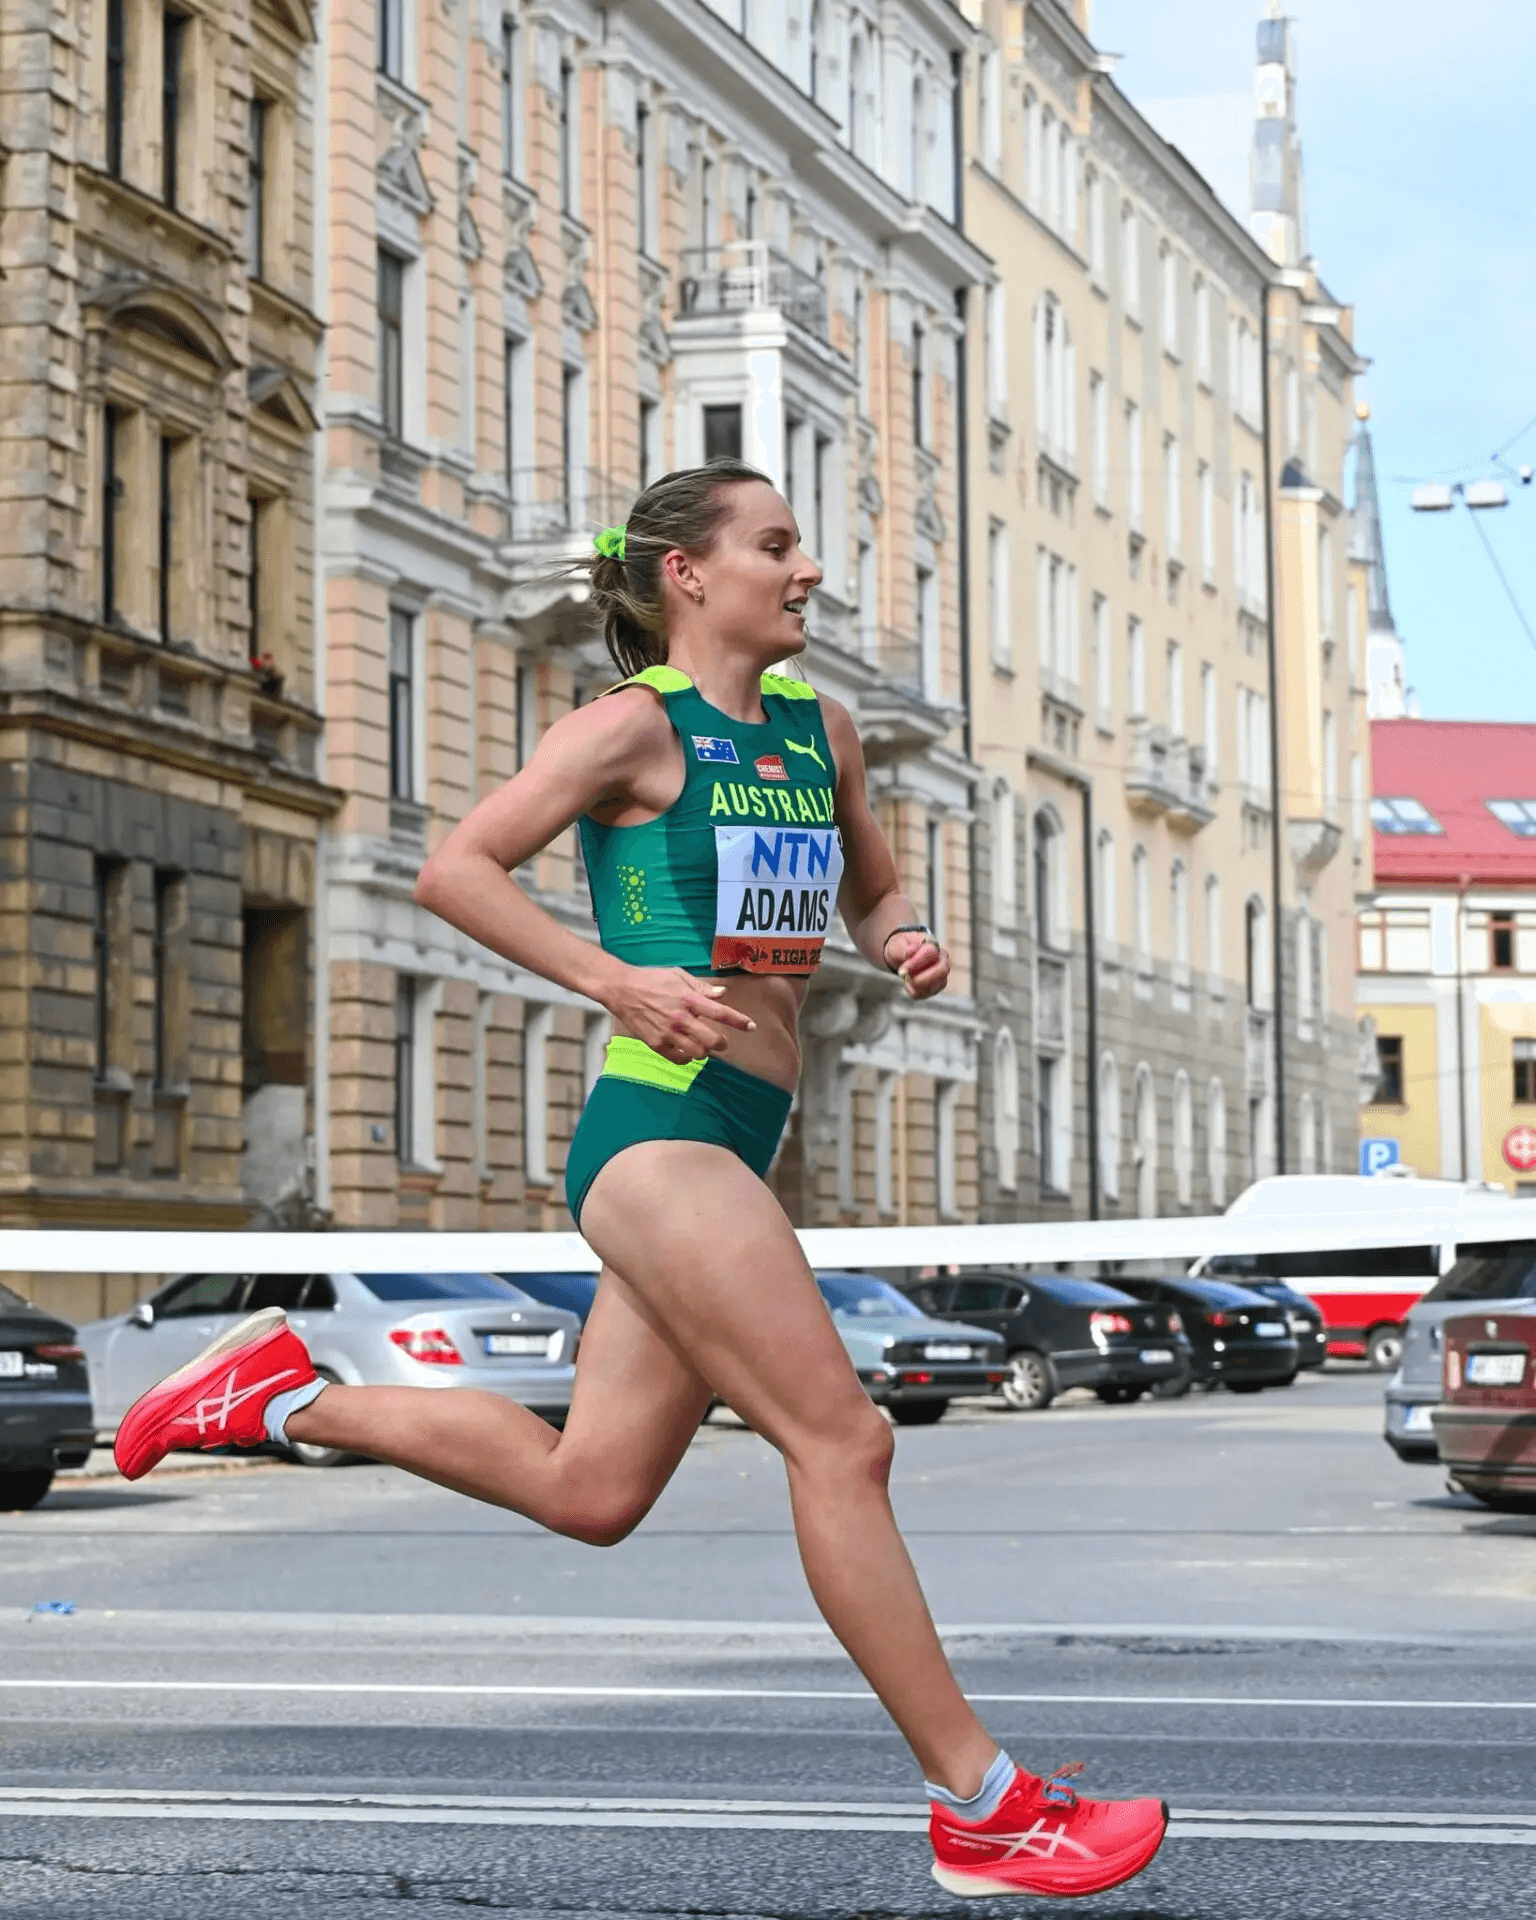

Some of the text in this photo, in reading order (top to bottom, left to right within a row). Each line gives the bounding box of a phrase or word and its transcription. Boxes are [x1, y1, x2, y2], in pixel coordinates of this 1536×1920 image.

[751, 831, 832, 880] NTN
[736, 888, 830, 932] ADAMS
[1369, 1143, 1390, 1171] P
